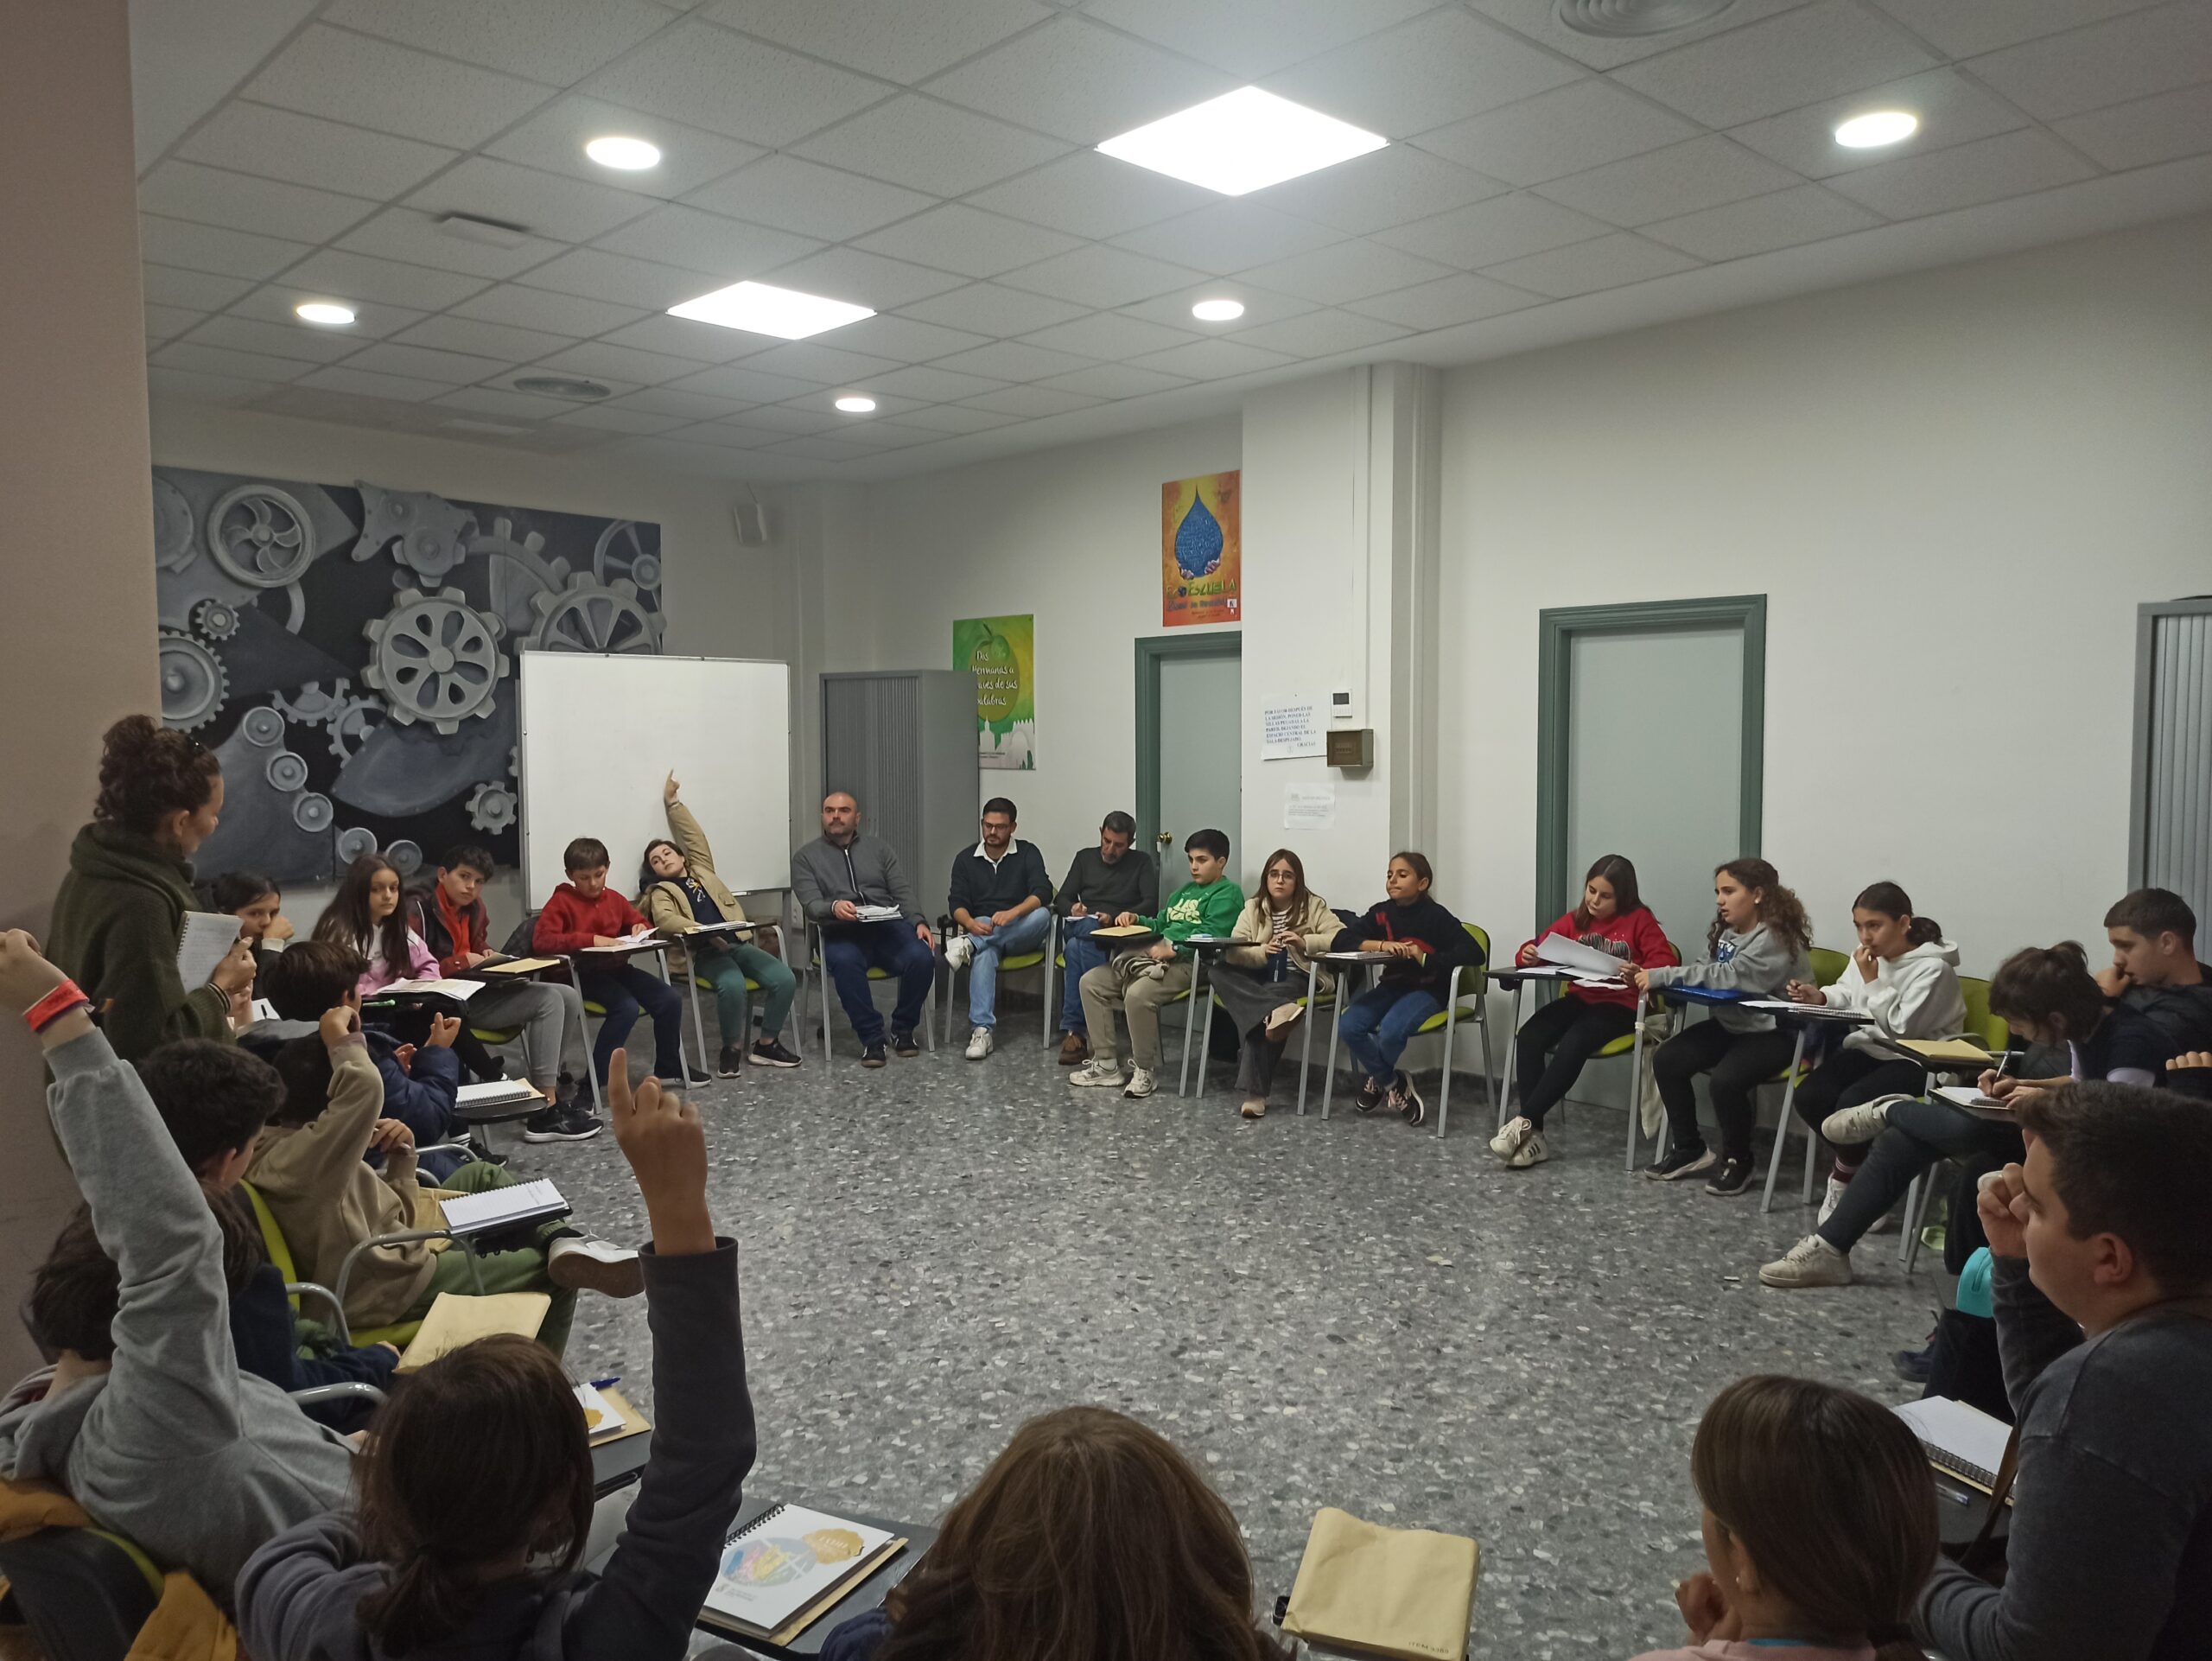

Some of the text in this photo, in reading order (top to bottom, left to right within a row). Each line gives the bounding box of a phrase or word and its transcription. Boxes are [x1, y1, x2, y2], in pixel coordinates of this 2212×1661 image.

[976, 650, 988, 661] Dos
[995, 677, 1004, 689] de
[1005, 679, 1018, 690] sus
